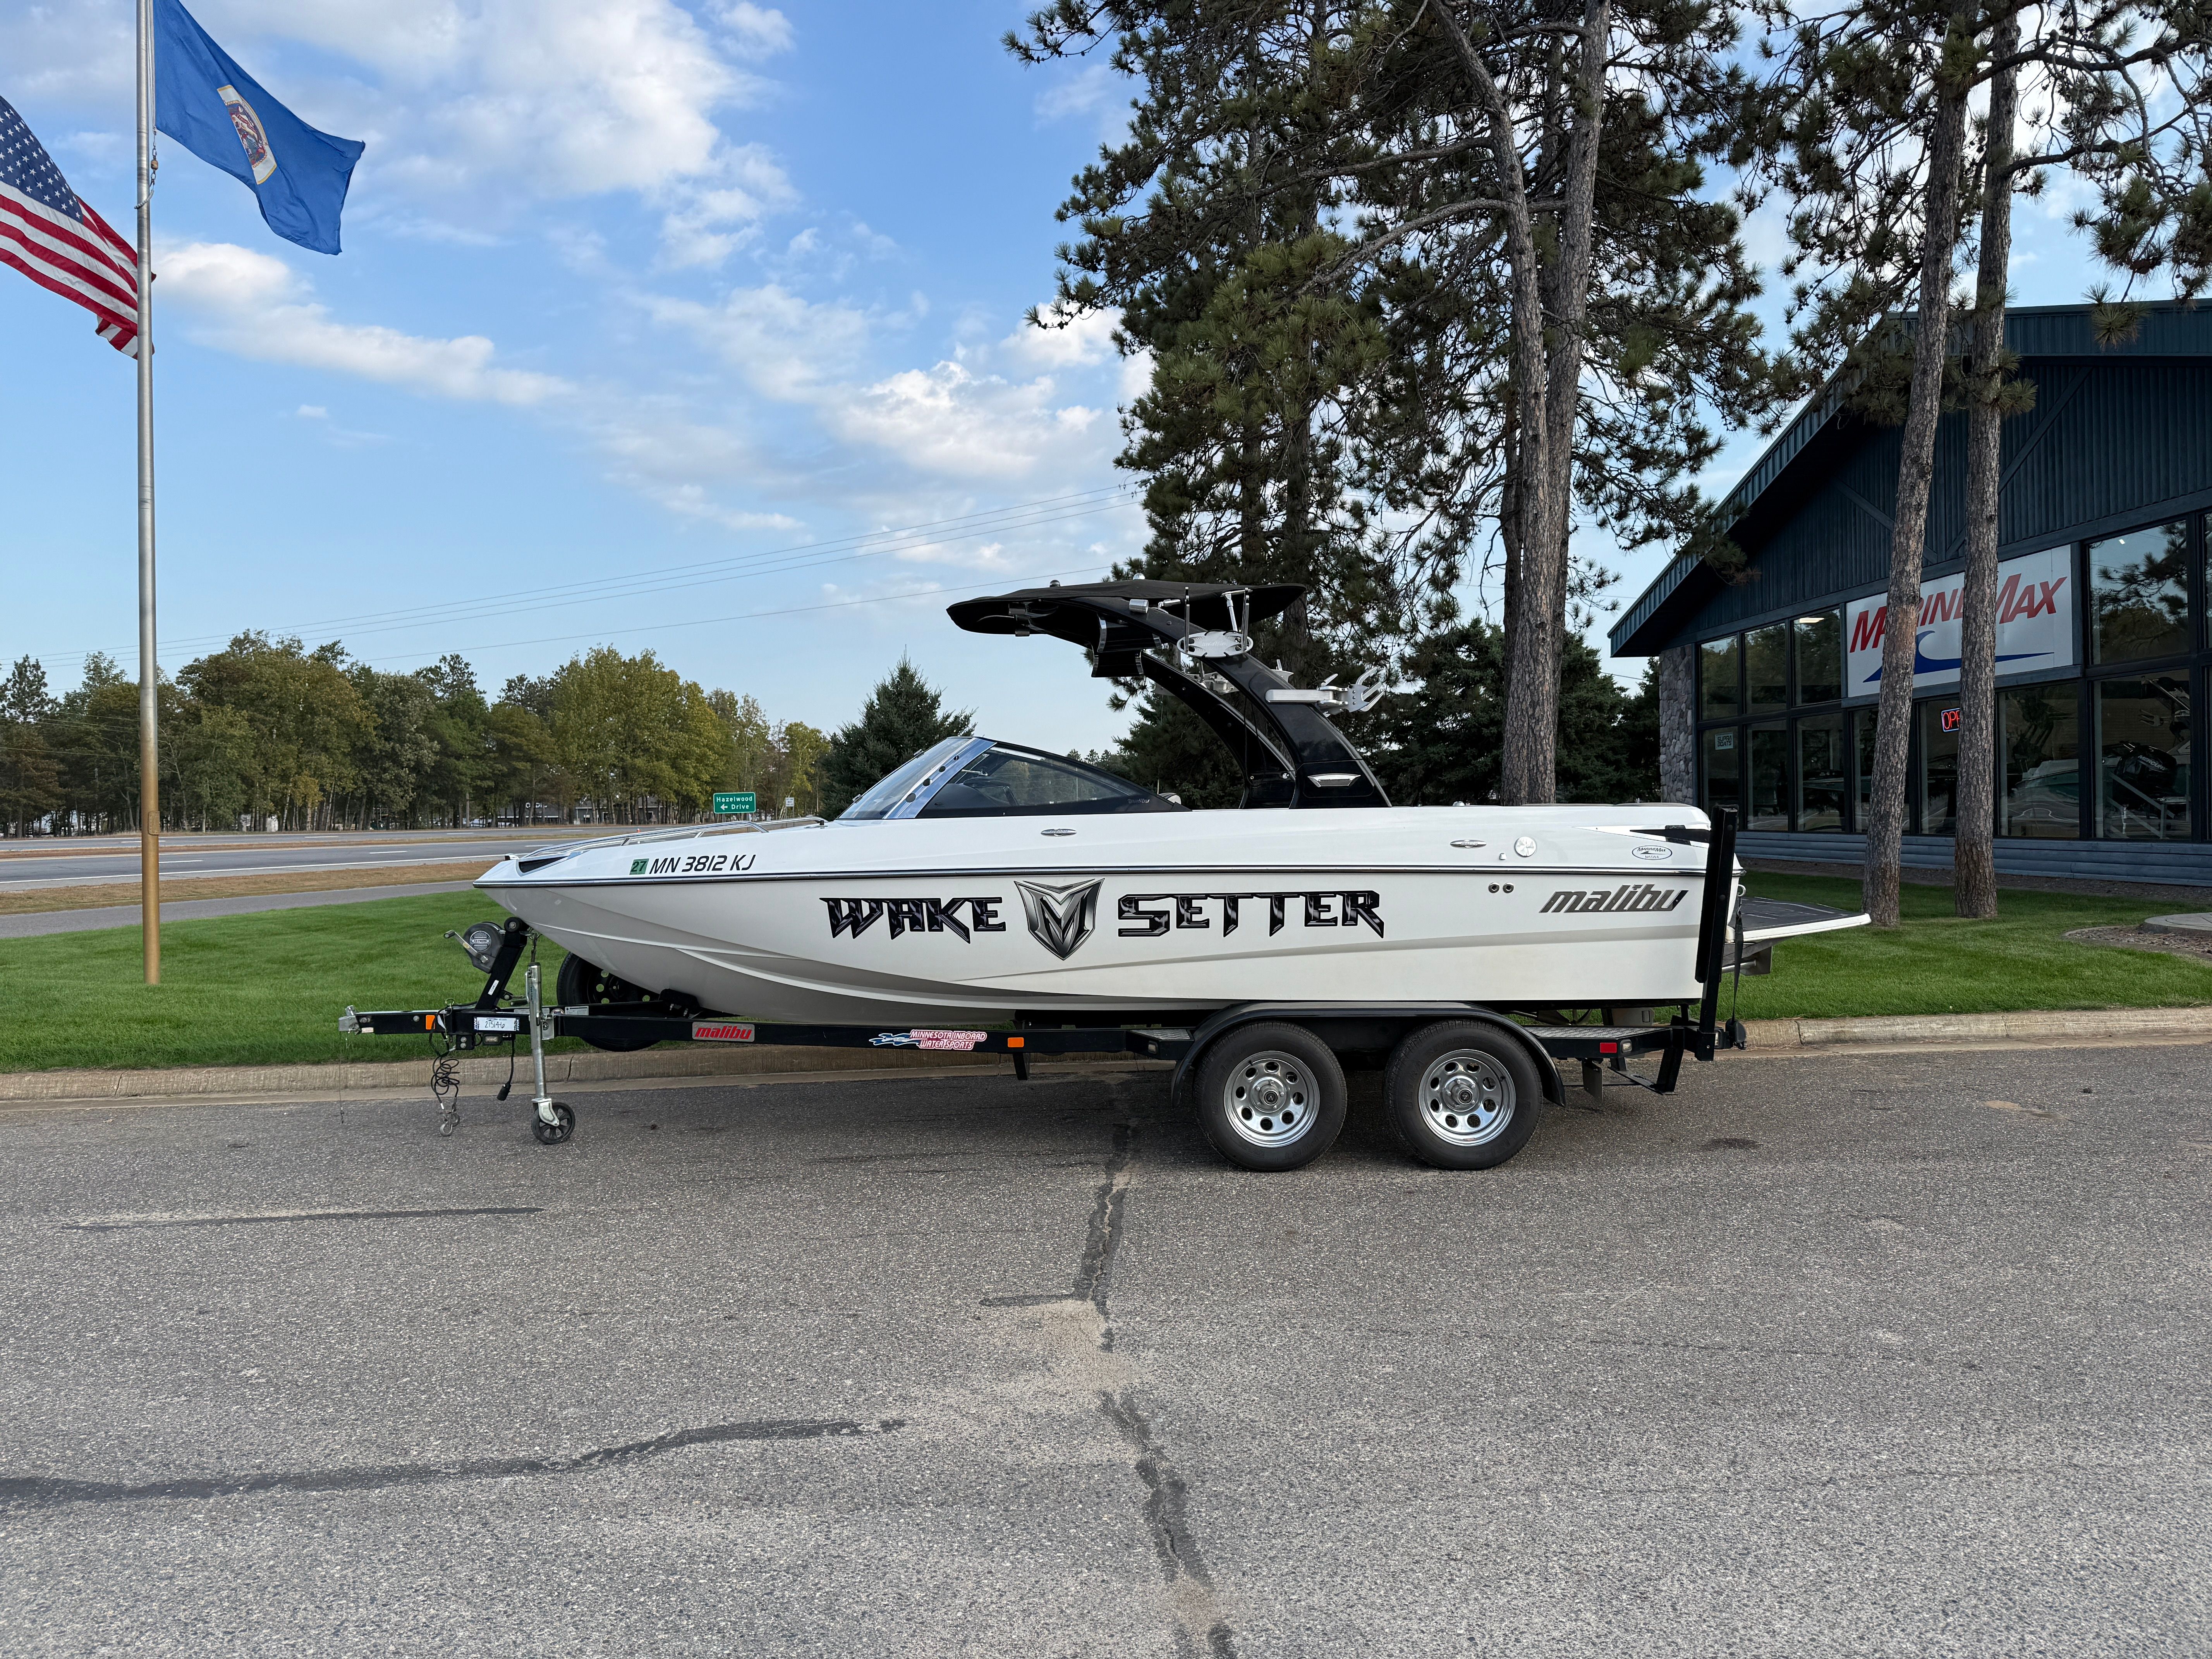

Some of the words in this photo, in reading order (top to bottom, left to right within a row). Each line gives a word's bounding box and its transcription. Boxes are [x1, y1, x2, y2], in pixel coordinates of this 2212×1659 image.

[1850, 573, 2068, 653] MINMAX
[1943, 710, 1960, 729] OPE
[2138, 755, 2168, 771] MERCURY
[631, 860, 647, 872] 27
[649, 857, 681, 874] MN
[682, 855, 728, 872] 3812
[730, 854, 756, 871] KJ
[1539, 884, 1689, 913] malibu
[819, 896, 1006, 944] WAKE
[1117, 890, 1384, 939] SETTER
[695, 1025, 752, 1039] malibu
[910, 1030, 952, 1039] MINNESOTA
[953, 1032, 986, 1041] INBOARD
[945, 1041, 973, 1049] SPORTS
